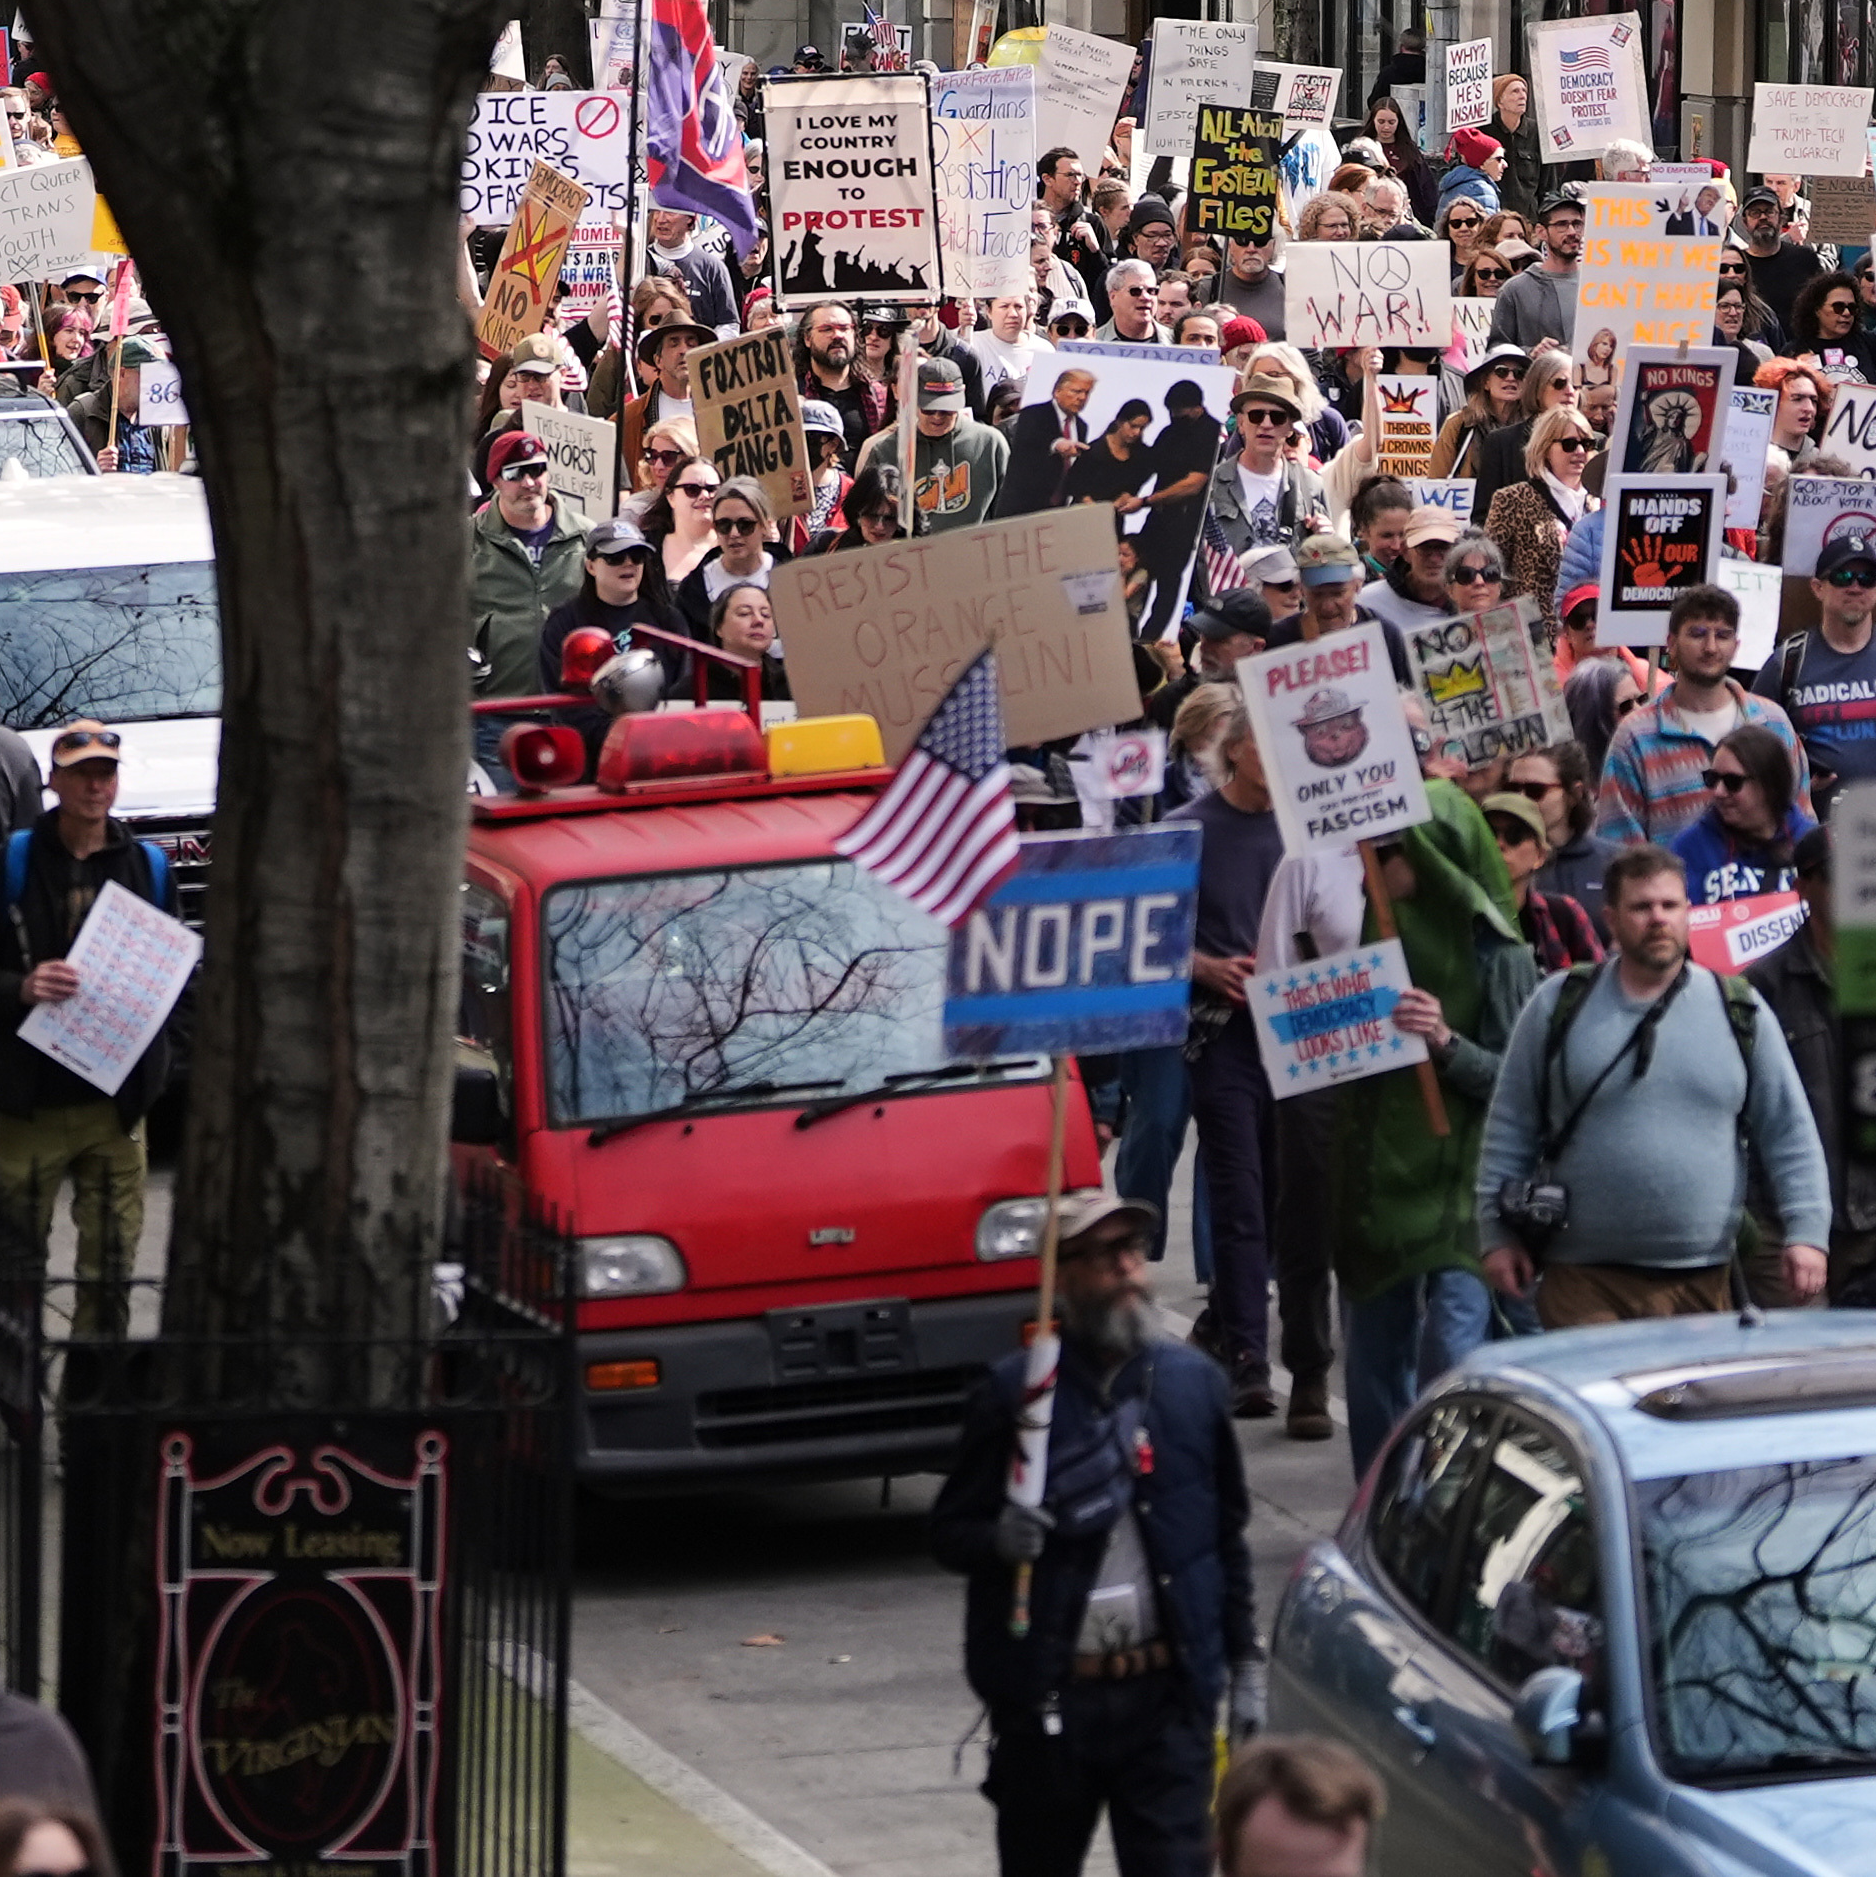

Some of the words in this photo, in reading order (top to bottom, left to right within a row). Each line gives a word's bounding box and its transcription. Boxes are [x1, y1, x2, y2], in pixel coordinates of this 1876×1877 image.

[1450, 45, 1486, 64] WHY?
[1449, 63, 1488, 85] BECAUSE
[1560, 73, 1614, 90] DEMOCRACY
[1456, 84, 1482, 103] HE'S
[1560, 90, 1594, 103] DOESN'T
[1597, 88, 1617, 101] FEAR
[1766, 92, 1798, 108] SAVE
[1805, 92, 1865, 109] DEMOCRACY
[488, 97, 546, 124] ICE
[808, 115, 861, 129] LOVE
[869, 114, 897, 128] MY
[1450, 101, 1489, 124] INSANE!
[488, 129, 568, 154] WARS
[800, 135, 896, 150] COUNTRY
[1771, 128, 1845, 144] TRUMP-TECH
[1784, 146, 1841, 162] OLIGARCHY
[784, 158, 916, 180] ENOUGH
[530, 167, 585, 211] DEMOCRACY
[839, 188, 865, 200] TO
[2, 195, 75, 224] TRANS
[783, 208, 924, 230] PROTEST
[1592, 198, 1651, 227] THIS
[47, 253, 86, 268] KINGS
[1586, 240, 1610, 267] IS
[1620, 241, 1675, 268] WHY
[1683, 245, 1718, 271] WE
[494, 279, 528, 322] NO
[1580, 282, 1648, 308] CAN'T
[1653, 284, 1714, 310] HAVE
[700, 329, 787, 402] FOXTROT
[1647, 369, 1672, 386] NO
[1677, 369, 1715, 389] KINGS
[725, 391, 794, 440] DELTA
[714, 436, 795, 480] TANGO
[1630, 496, 1702, 516] HANDS
[1645, 515, 1683, 534] OFF
[1665, 543, 1698, 563] OUR
[797, 544, 926, 610] RESIST
[973, 525, 1056, 579] THE
[854, 585, 1034, 668] ORANGE
[1267, 641, 1369, 696] PLEASE!
[1789, 678, 1872, 704] RADICAL
[1297, 776, 1347, 802] ONLY
[1356, 759, 1397, 784] YOU
[1307, 797, 1409, 838] FASCISM
[203, 1528, 271, 1560] Now
[284, 1527, 402, 1564] Leasing
